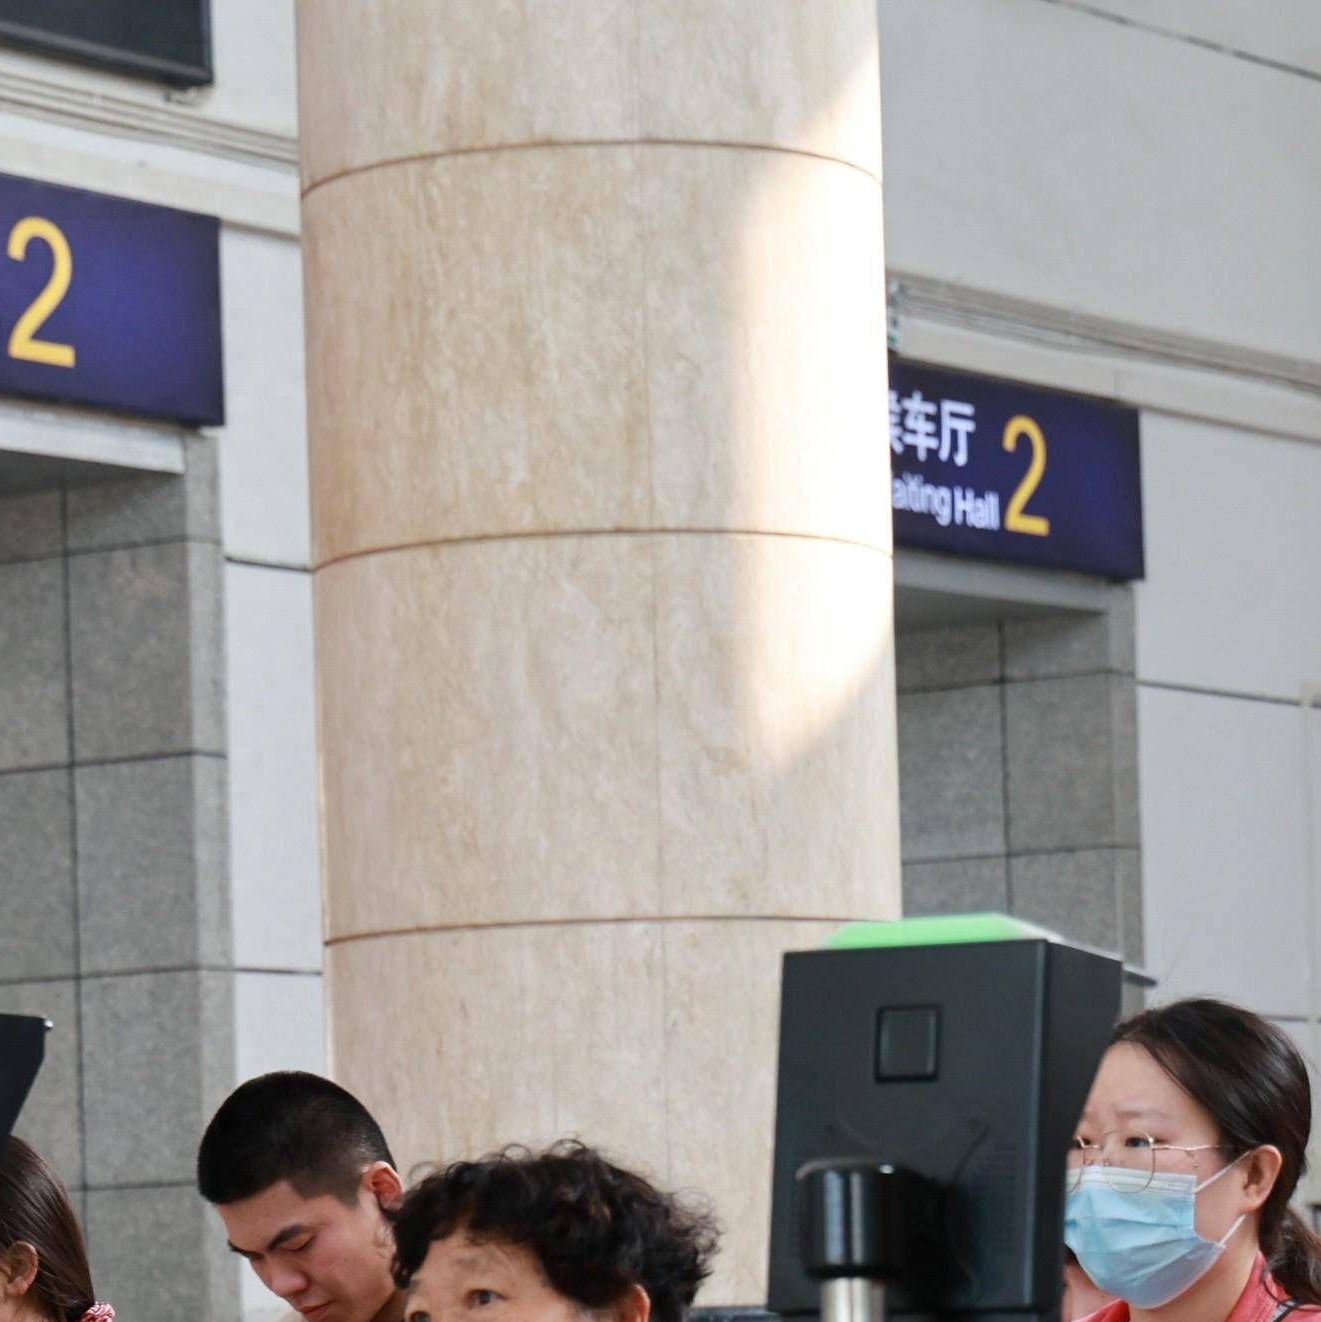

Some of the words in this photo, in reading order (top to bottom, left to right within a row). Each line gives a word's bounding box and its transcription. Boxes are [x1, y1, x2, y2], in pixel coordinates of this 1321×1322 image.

[6, 216, 76, 368] 2
[892, 471, 952, 526] aiting
[953, 485, 1000, 531] Hall
[1002, 414, 1050, 537] 2
